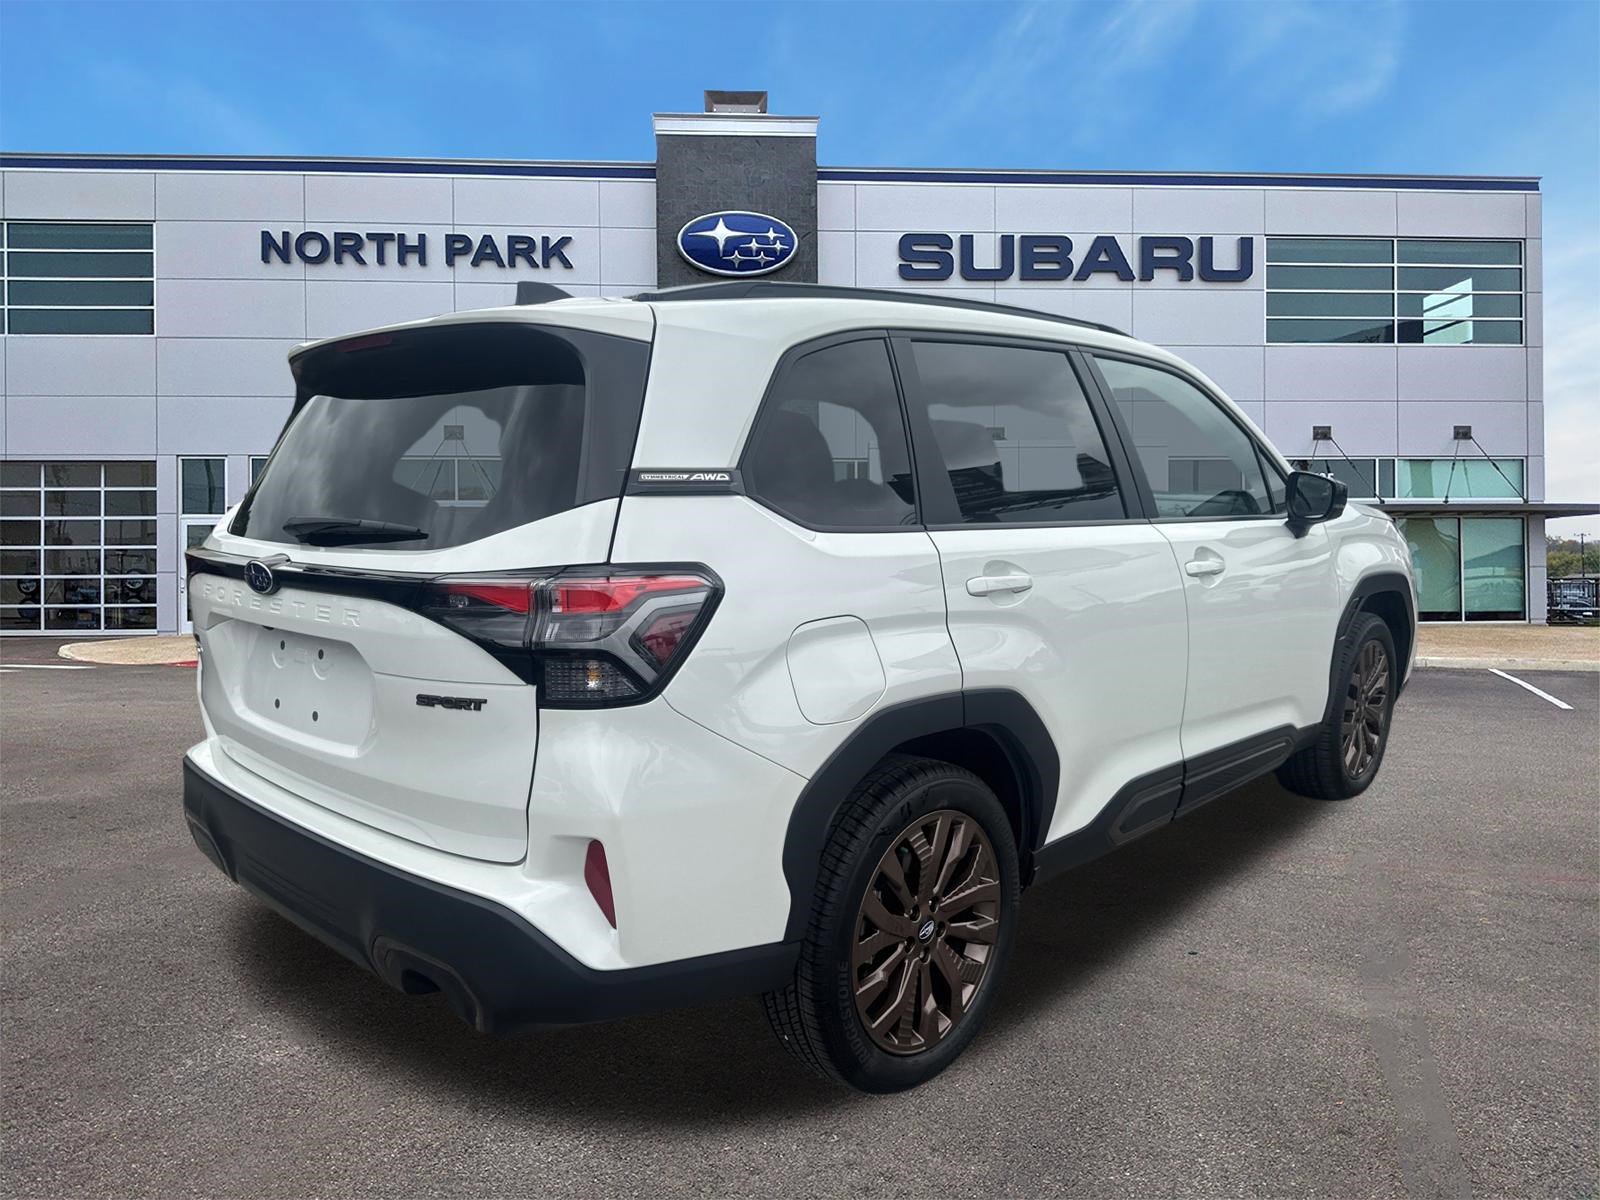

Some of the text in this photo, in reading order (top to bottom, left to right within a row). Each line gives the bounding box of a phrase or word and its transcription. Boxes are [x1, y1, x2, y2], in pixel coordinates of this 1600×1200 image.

[260, 230, 574, 269] NORTH PARK
[898, 233, 1254, 282] SUBARU
[202, 583, 361, 627] FORESTER
[416, 693, 488, 712] SPORT
